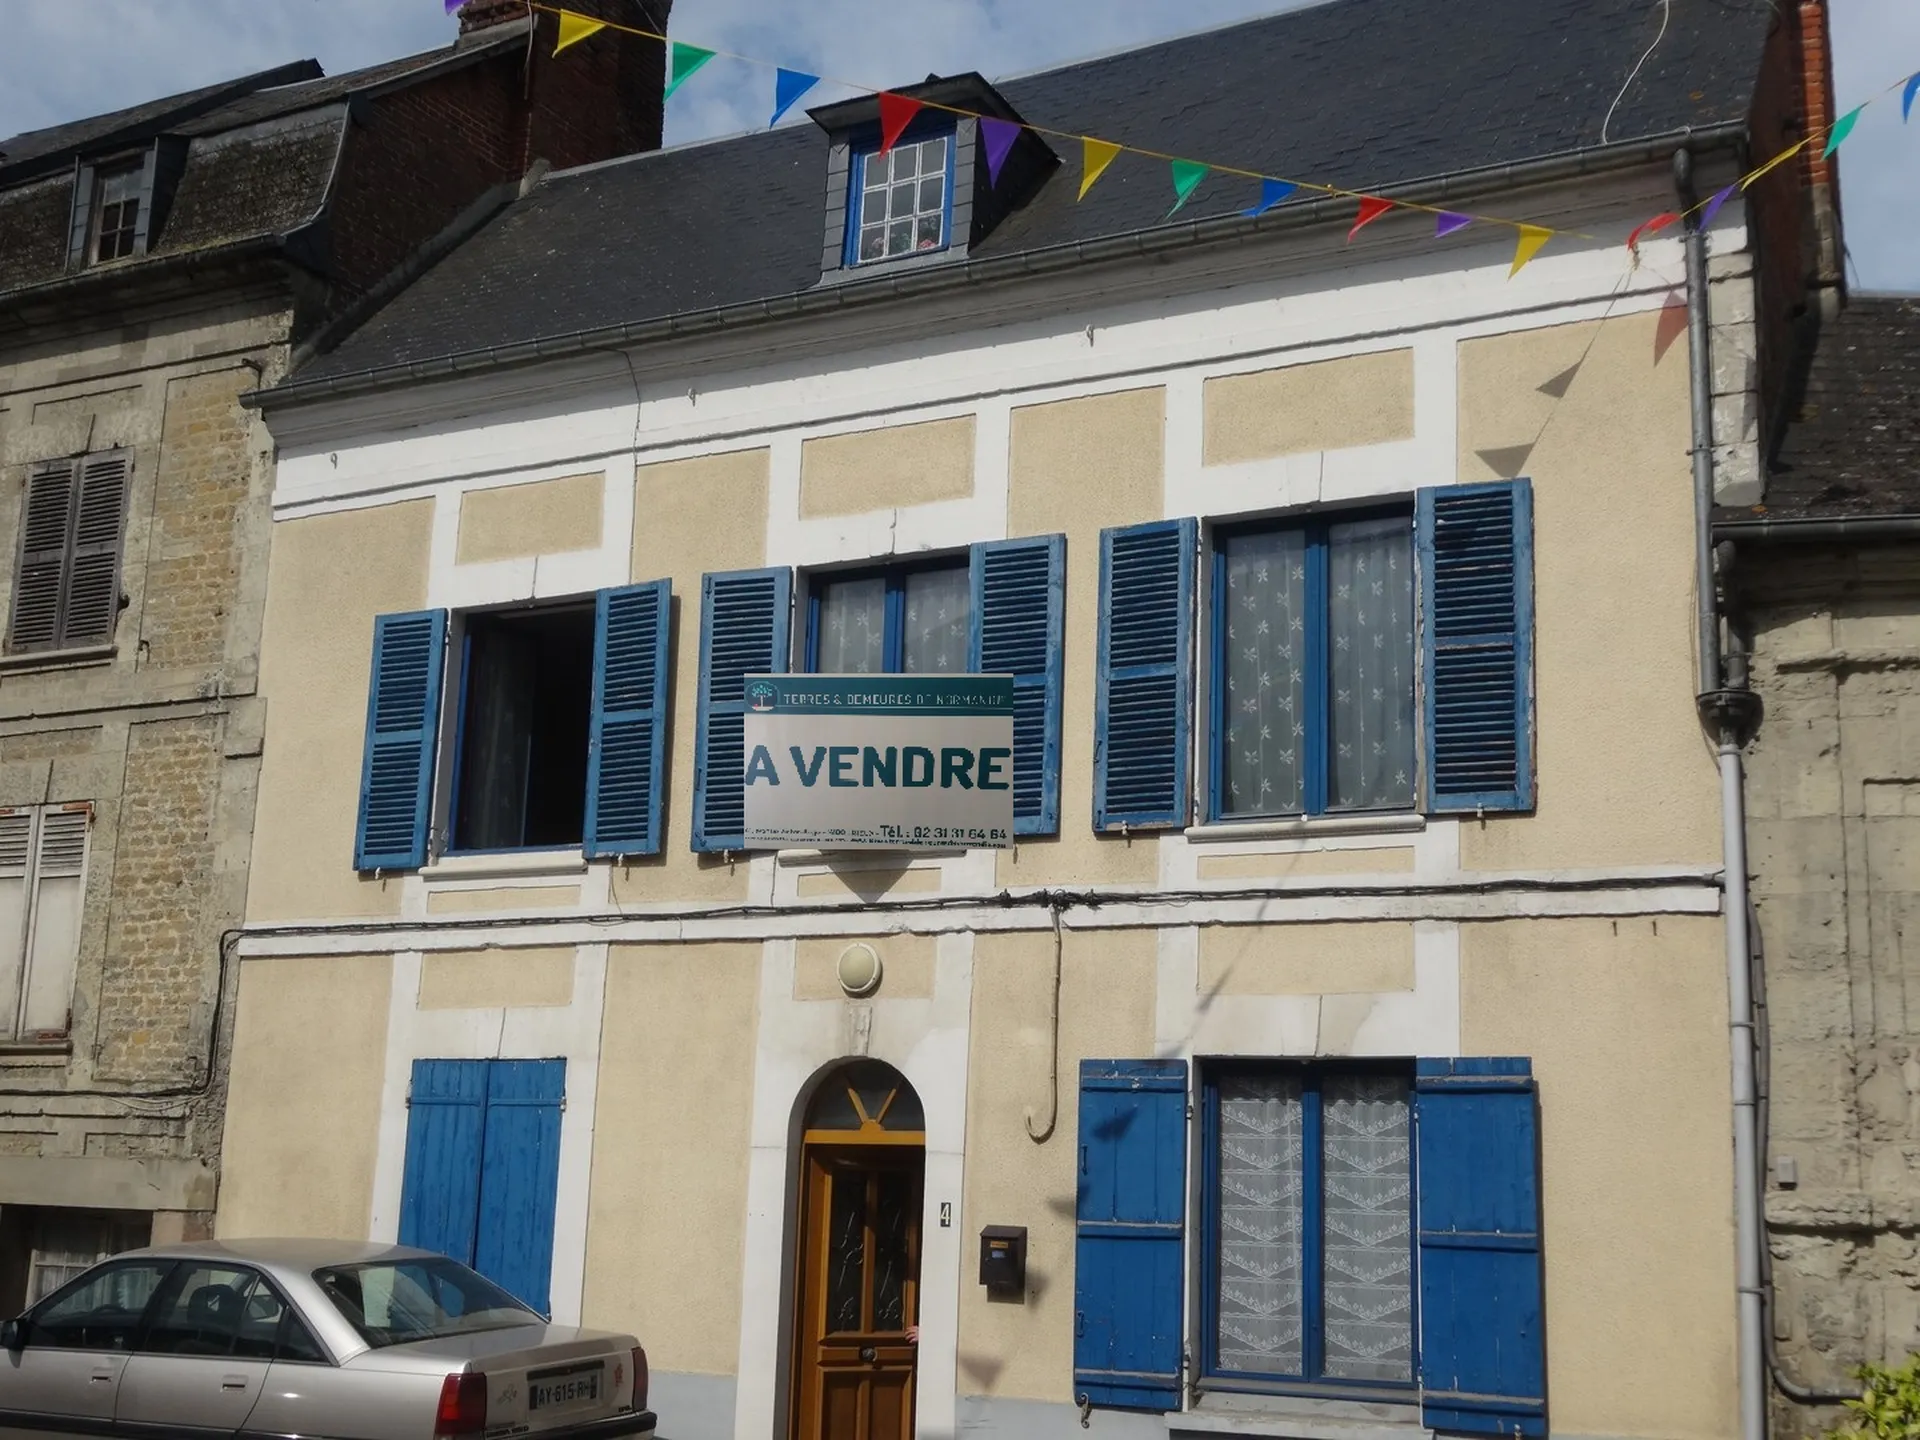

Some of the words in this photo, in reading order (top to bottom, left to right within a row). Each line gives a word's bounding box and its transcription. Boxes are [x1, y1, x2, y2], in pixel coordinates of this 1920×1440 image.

[783, 694, 830, 706] TERRES
[833, 694, 842, 706] &
[847, 694, 911, 706] DEMEURES
[745, 745, 780, 786] A
[789, 746, 1012, 790] VENDRE
[914, 826, 931, 838] 02
[933, 827, 948, 839] 31
[951, 828, 965, 839] 31
[968, 828, 986, 840] 64
[941, 1203, 950, 1226] 4
